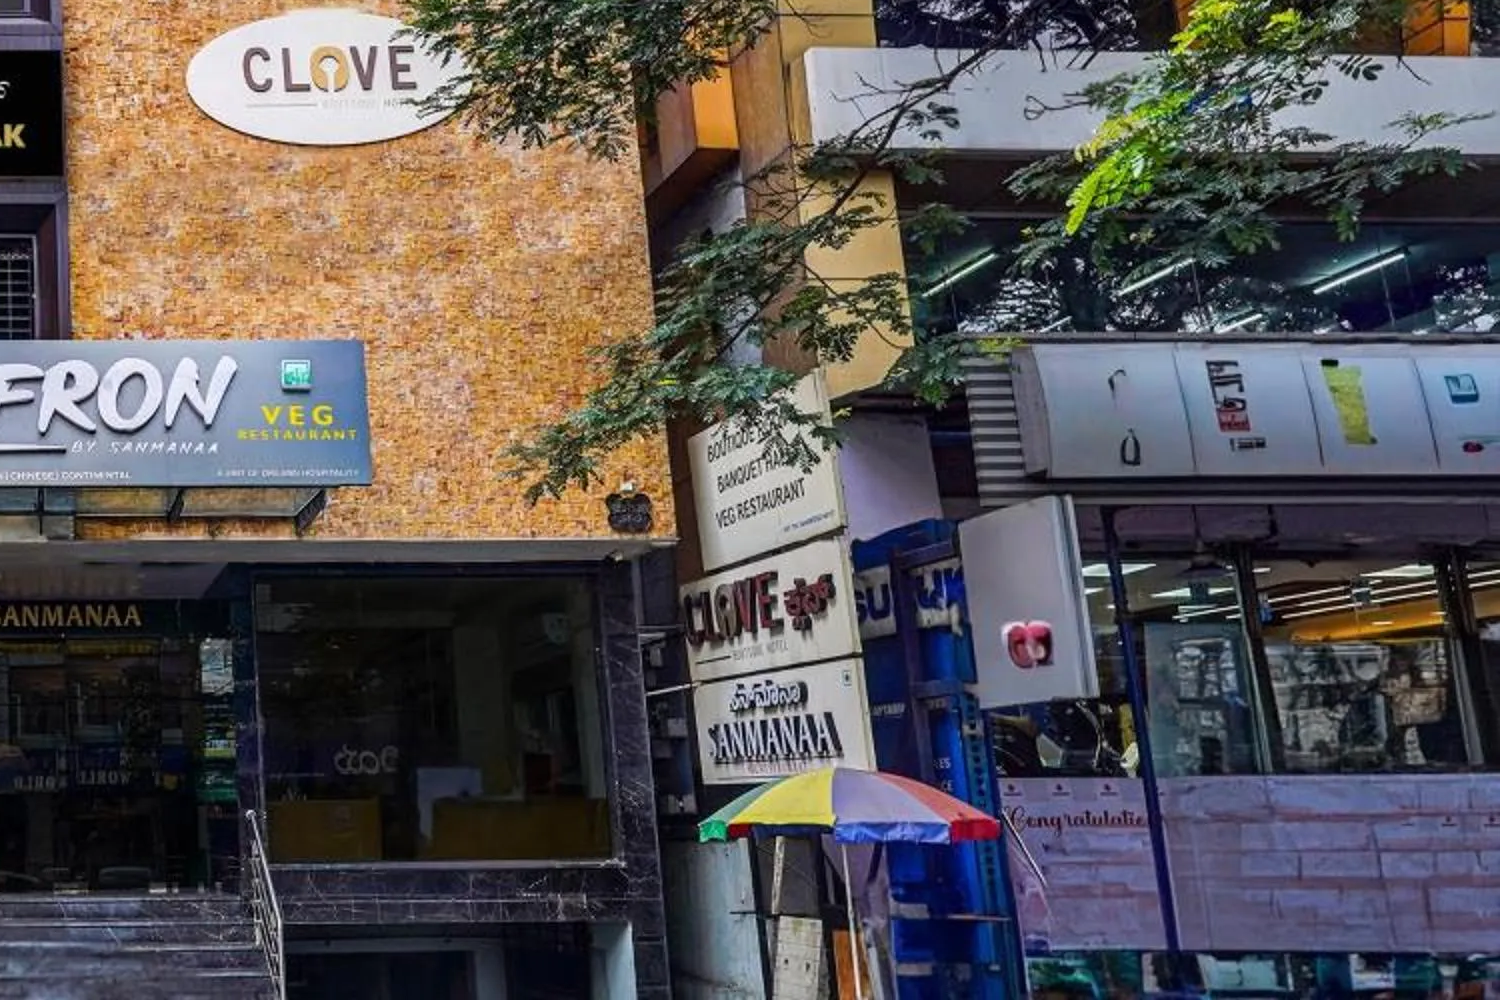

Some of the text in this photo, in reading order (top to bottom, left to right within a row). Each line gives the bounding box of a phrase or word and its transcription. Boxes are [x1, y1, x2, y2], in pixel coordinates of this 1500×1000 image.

[243, 46, 417, 93] CLOVE
[236, 428, 358, 441] RESTAURANT
[260, 404, 334, 425] VEG
[71, 439, 219, 454] BY SANMANAA
[717, 457, 764, 494] BANQUET
[715, 477, 805, 529] VEG RESTAURANT
[683, 570, 783, 646] CLOVE
[707, 712, 839, 763] SANMANAA
